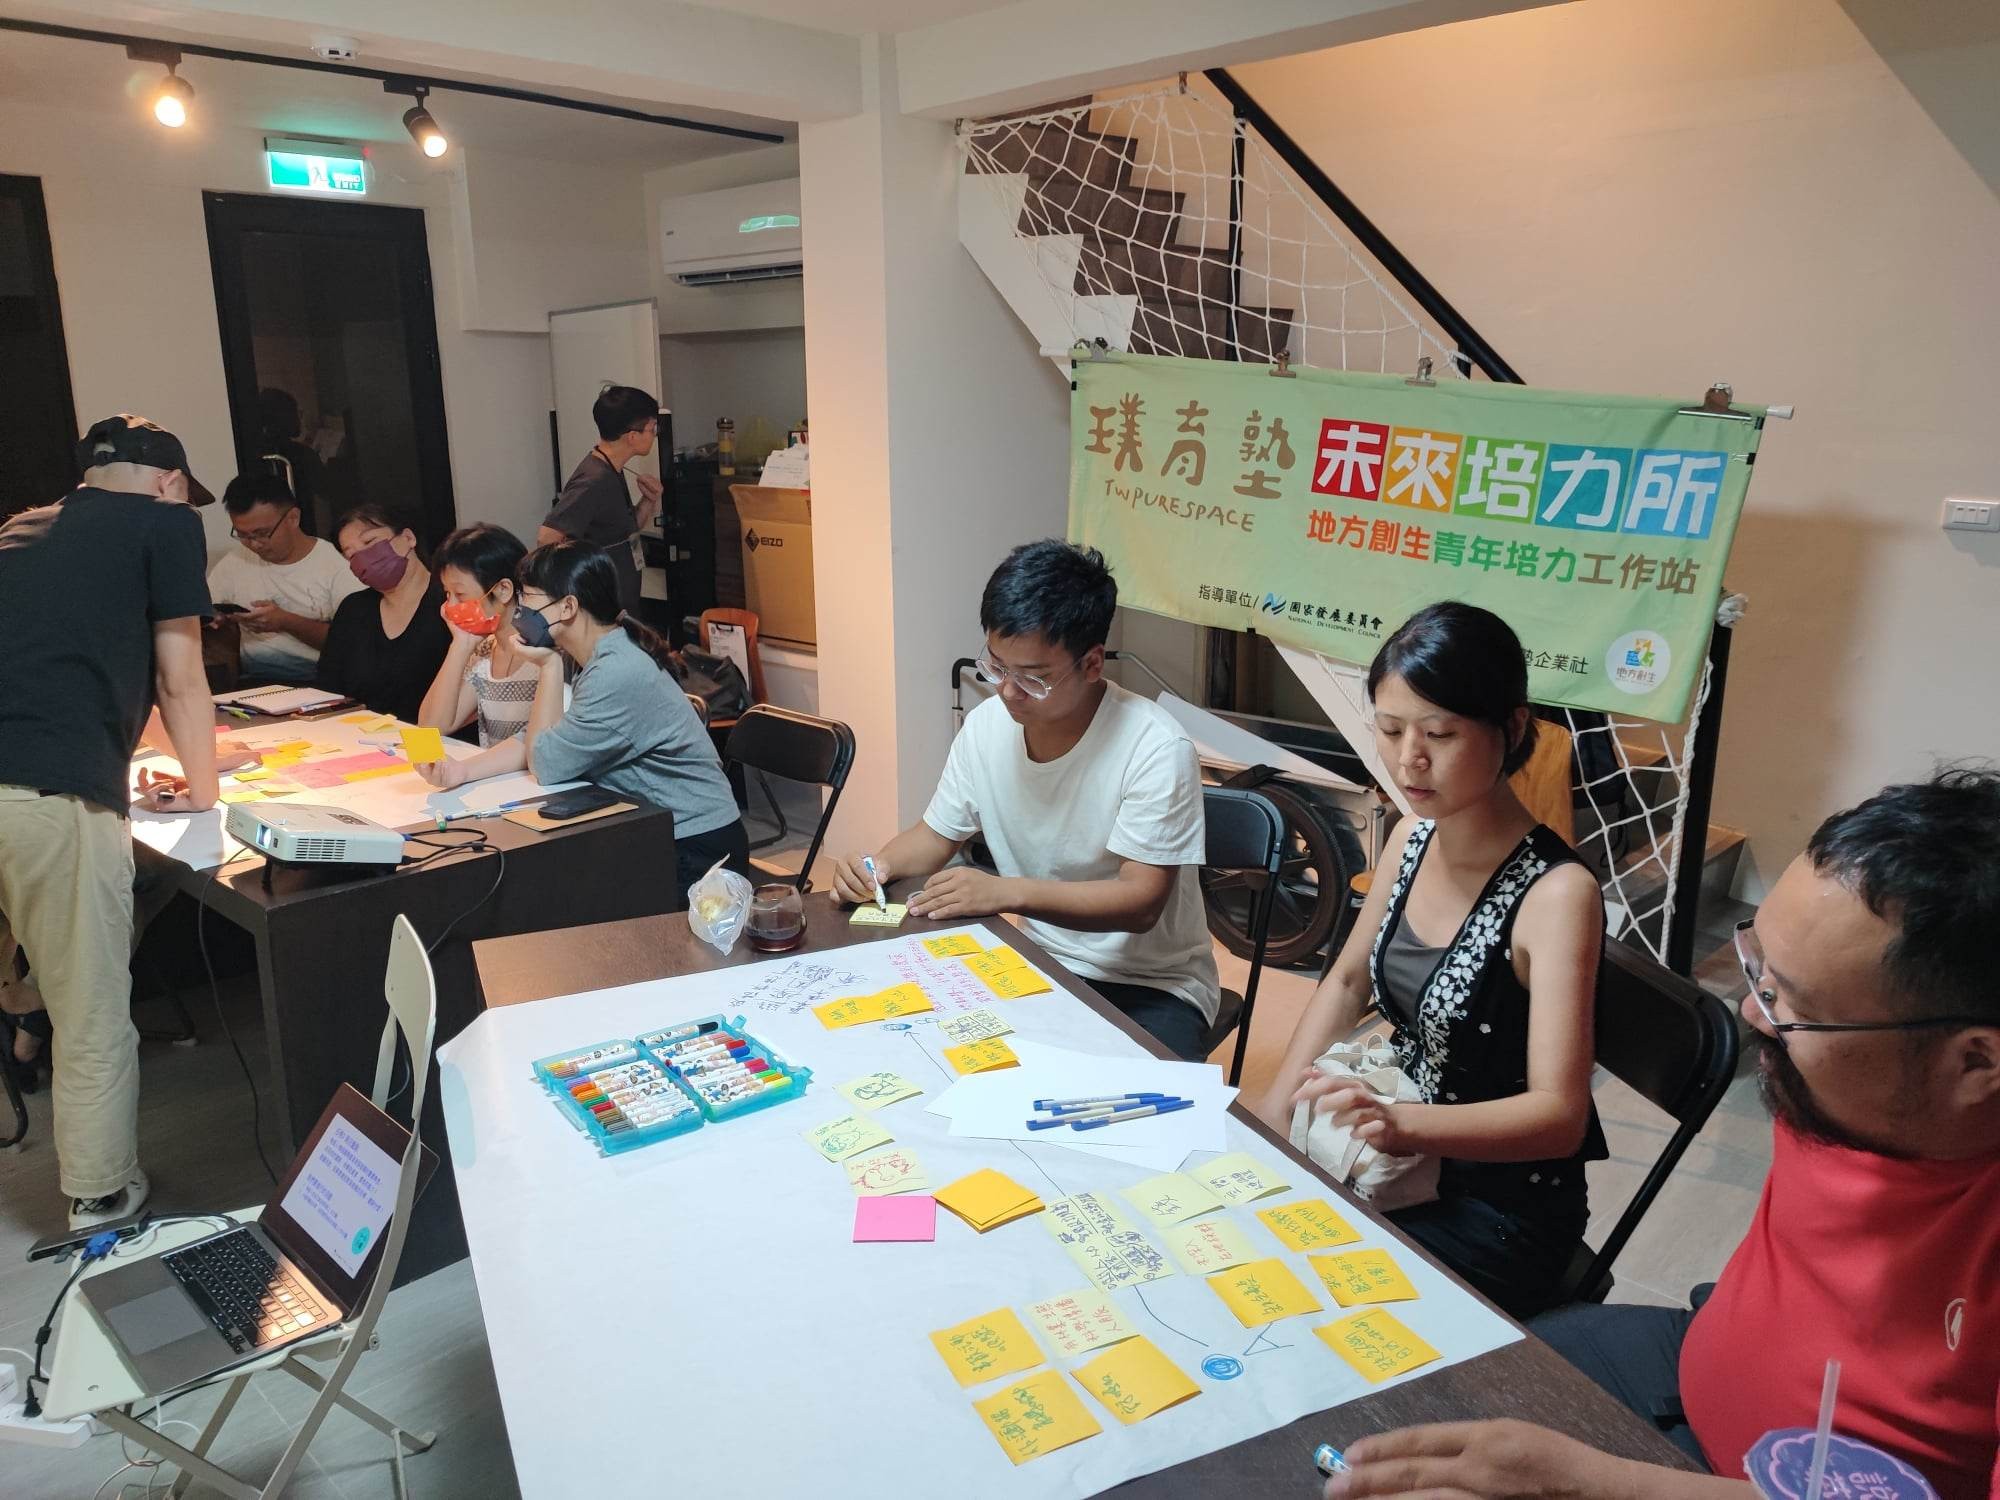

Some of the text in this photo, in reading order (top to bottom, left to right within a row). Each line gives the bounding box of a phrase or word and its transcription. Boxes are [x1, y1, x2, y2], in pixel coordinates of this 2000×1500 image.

[1316, 423, 1722, 535] 未來培力所
[760, 536, 783, 547] EIZO
[1306, 509, 1701, 595] 地方創生青年培力工作站
[1289, 601, 1383, 630] 國家發展委員會
[1616, 666, 1656, 683] 地方創生
